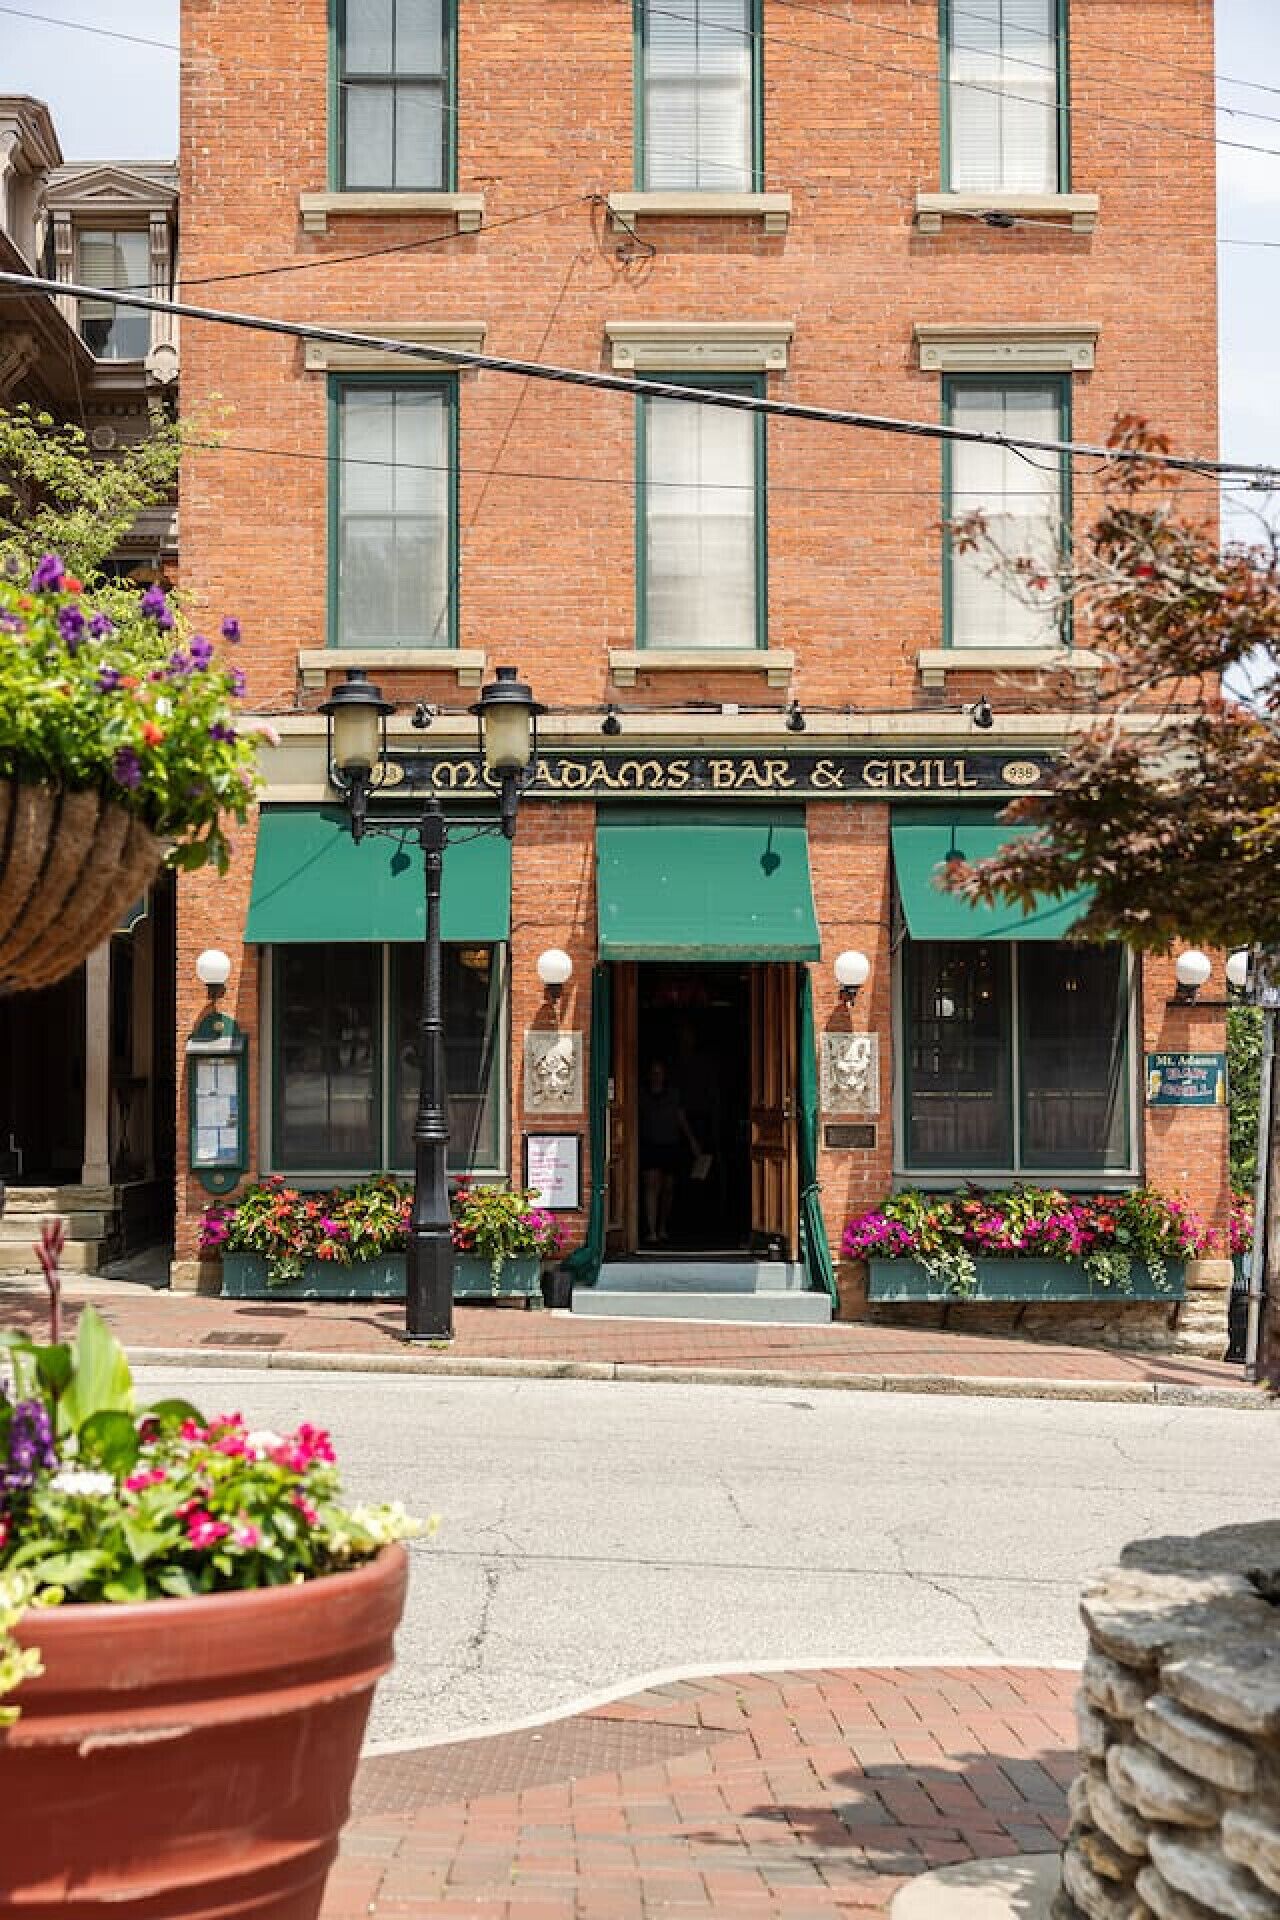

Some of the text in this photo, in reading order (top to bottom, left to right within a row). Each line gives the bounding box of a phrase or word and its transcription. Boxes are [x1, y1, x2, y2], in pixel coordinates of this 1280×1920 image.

[532, 759, 689, 787] ADAMS
[708, 760, 796, 788] BAR
[810, 761, 844, 787] &
[863, 760, 976, 787] GRILL
